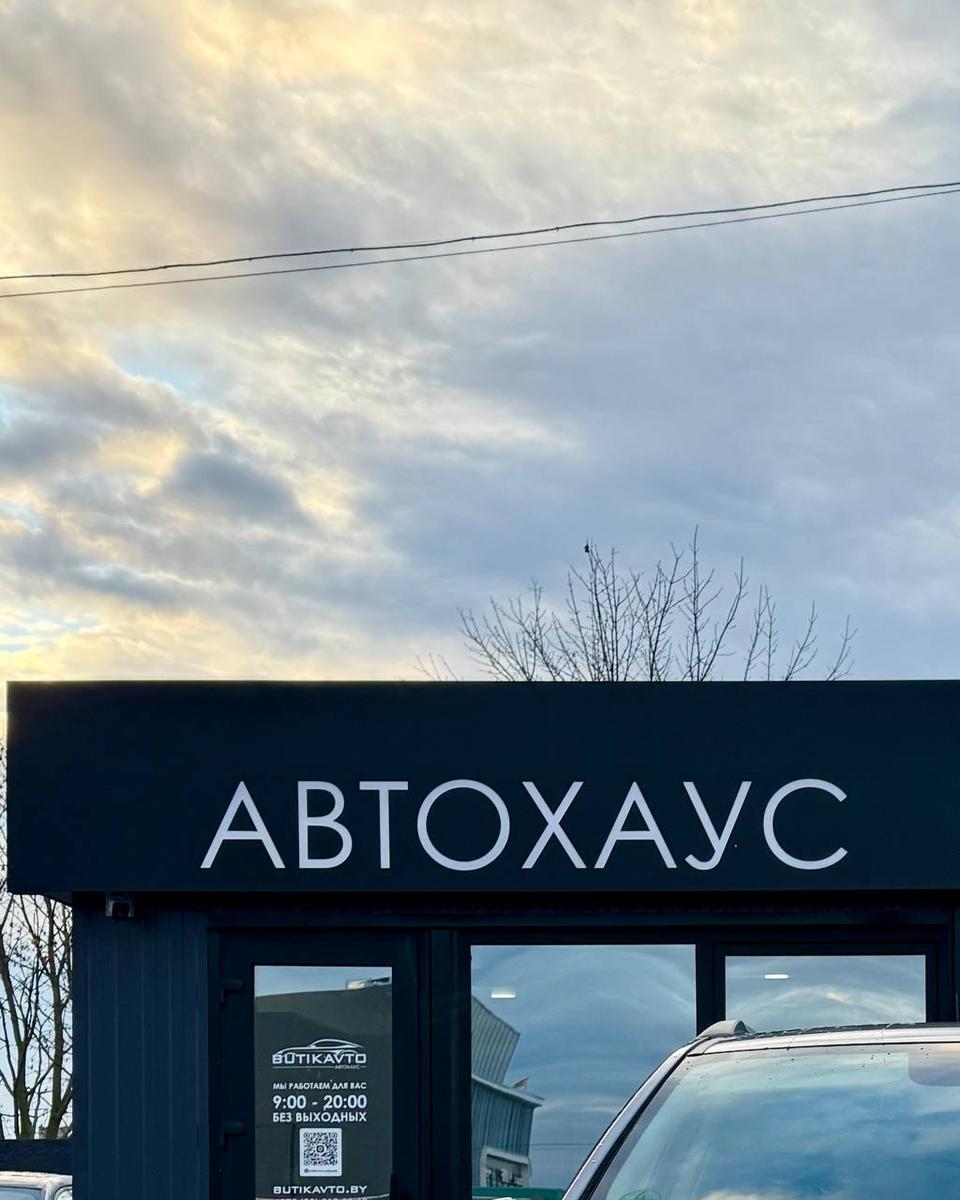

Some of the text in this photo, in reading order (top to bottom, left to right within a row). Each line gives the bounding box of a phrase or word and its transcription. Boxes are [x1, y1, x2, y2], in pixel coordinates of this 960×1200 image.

[200, 778, 848, 871] АВТОХАУС
[272, 1053, 367, 1065] BUTIKAVTO
[331, 1082, 348, 1090] ДЛЯ
[272, 1095, 308, 1109] 9:00
[323, 1094, 367, 1109] 20:00
[272, 1111, 367, 1123] БЕЗ ВЫХОДНЫХ
[273, 1185, 368, 1195] BUTIKAVTO.BY
